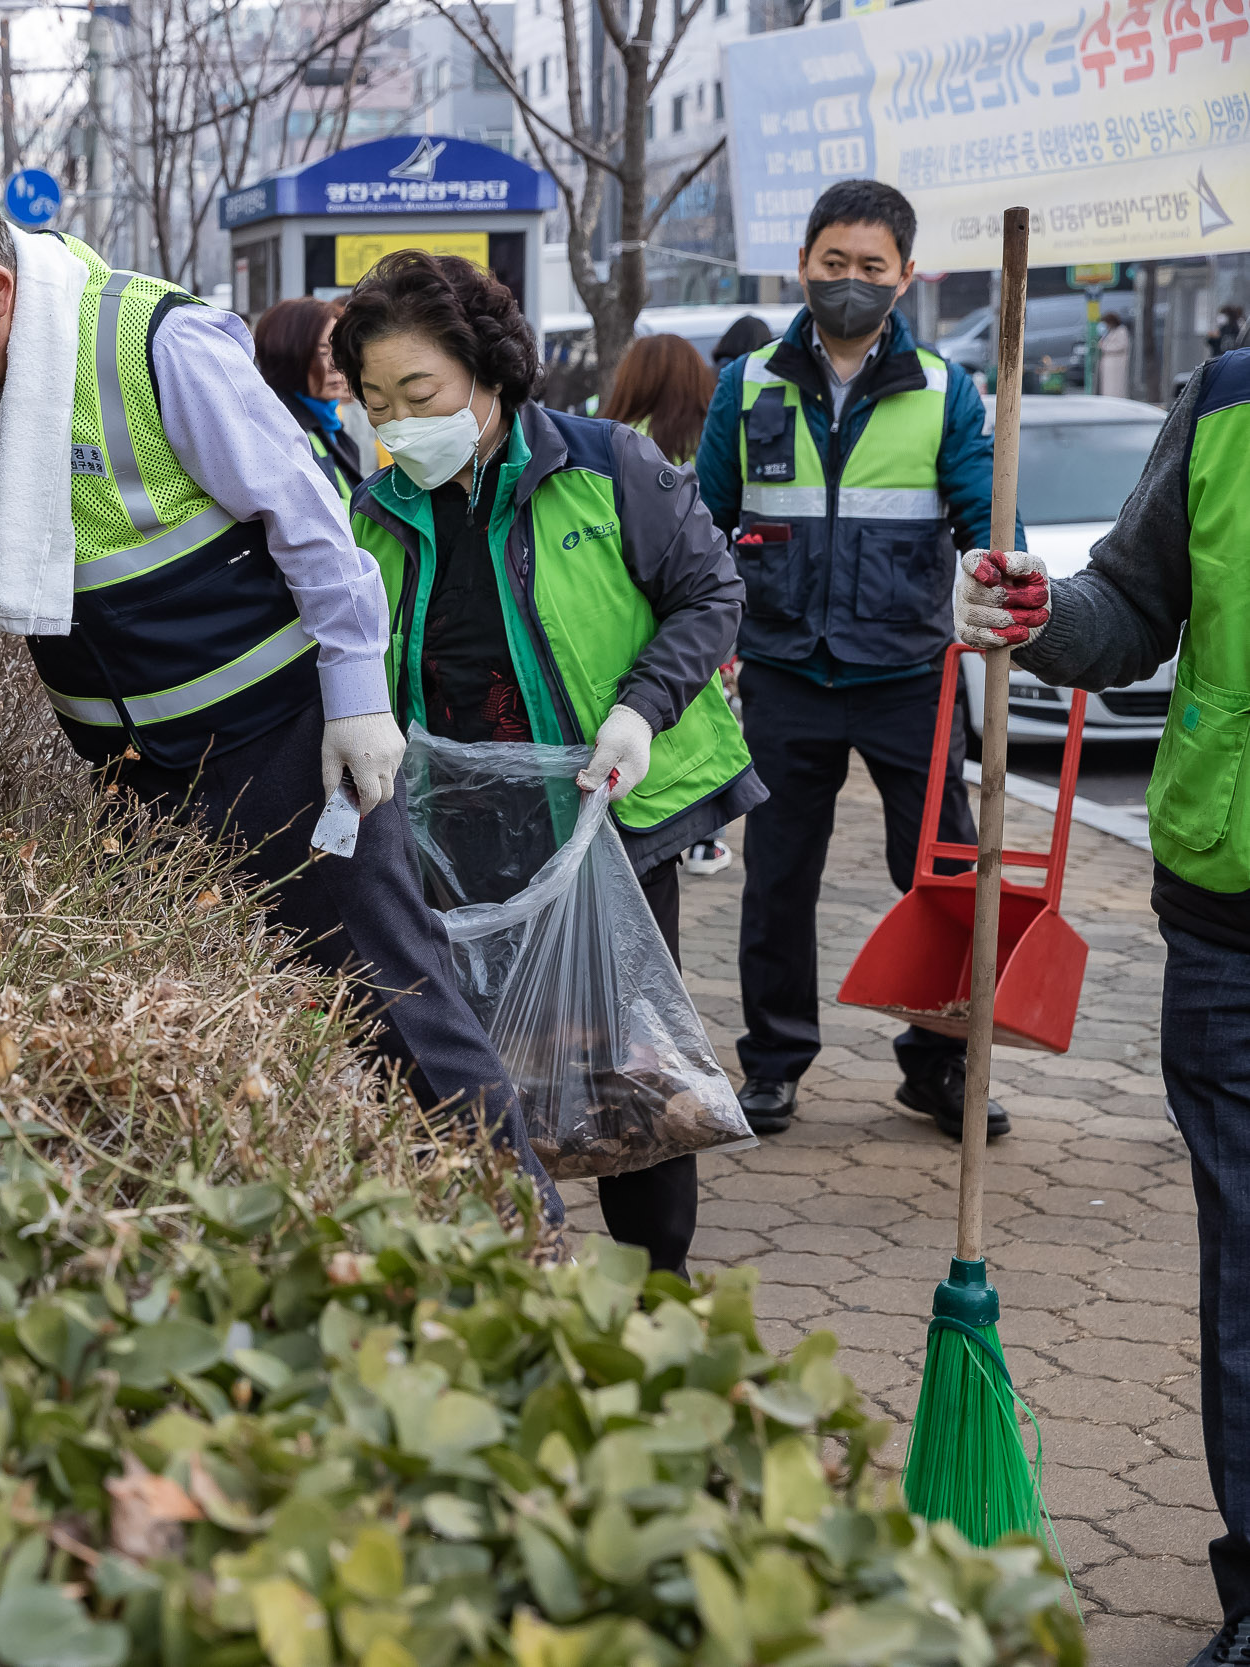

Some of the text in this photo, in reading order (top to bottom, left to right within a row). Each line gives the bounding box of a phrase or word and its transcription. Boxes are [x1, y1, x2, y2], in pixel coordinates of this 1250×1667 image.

[325, 180, 510, 203] 광진구시설관리공단
[73, 447, 101, 461] 경 호
[582, 521, 615, 537] 광진구
